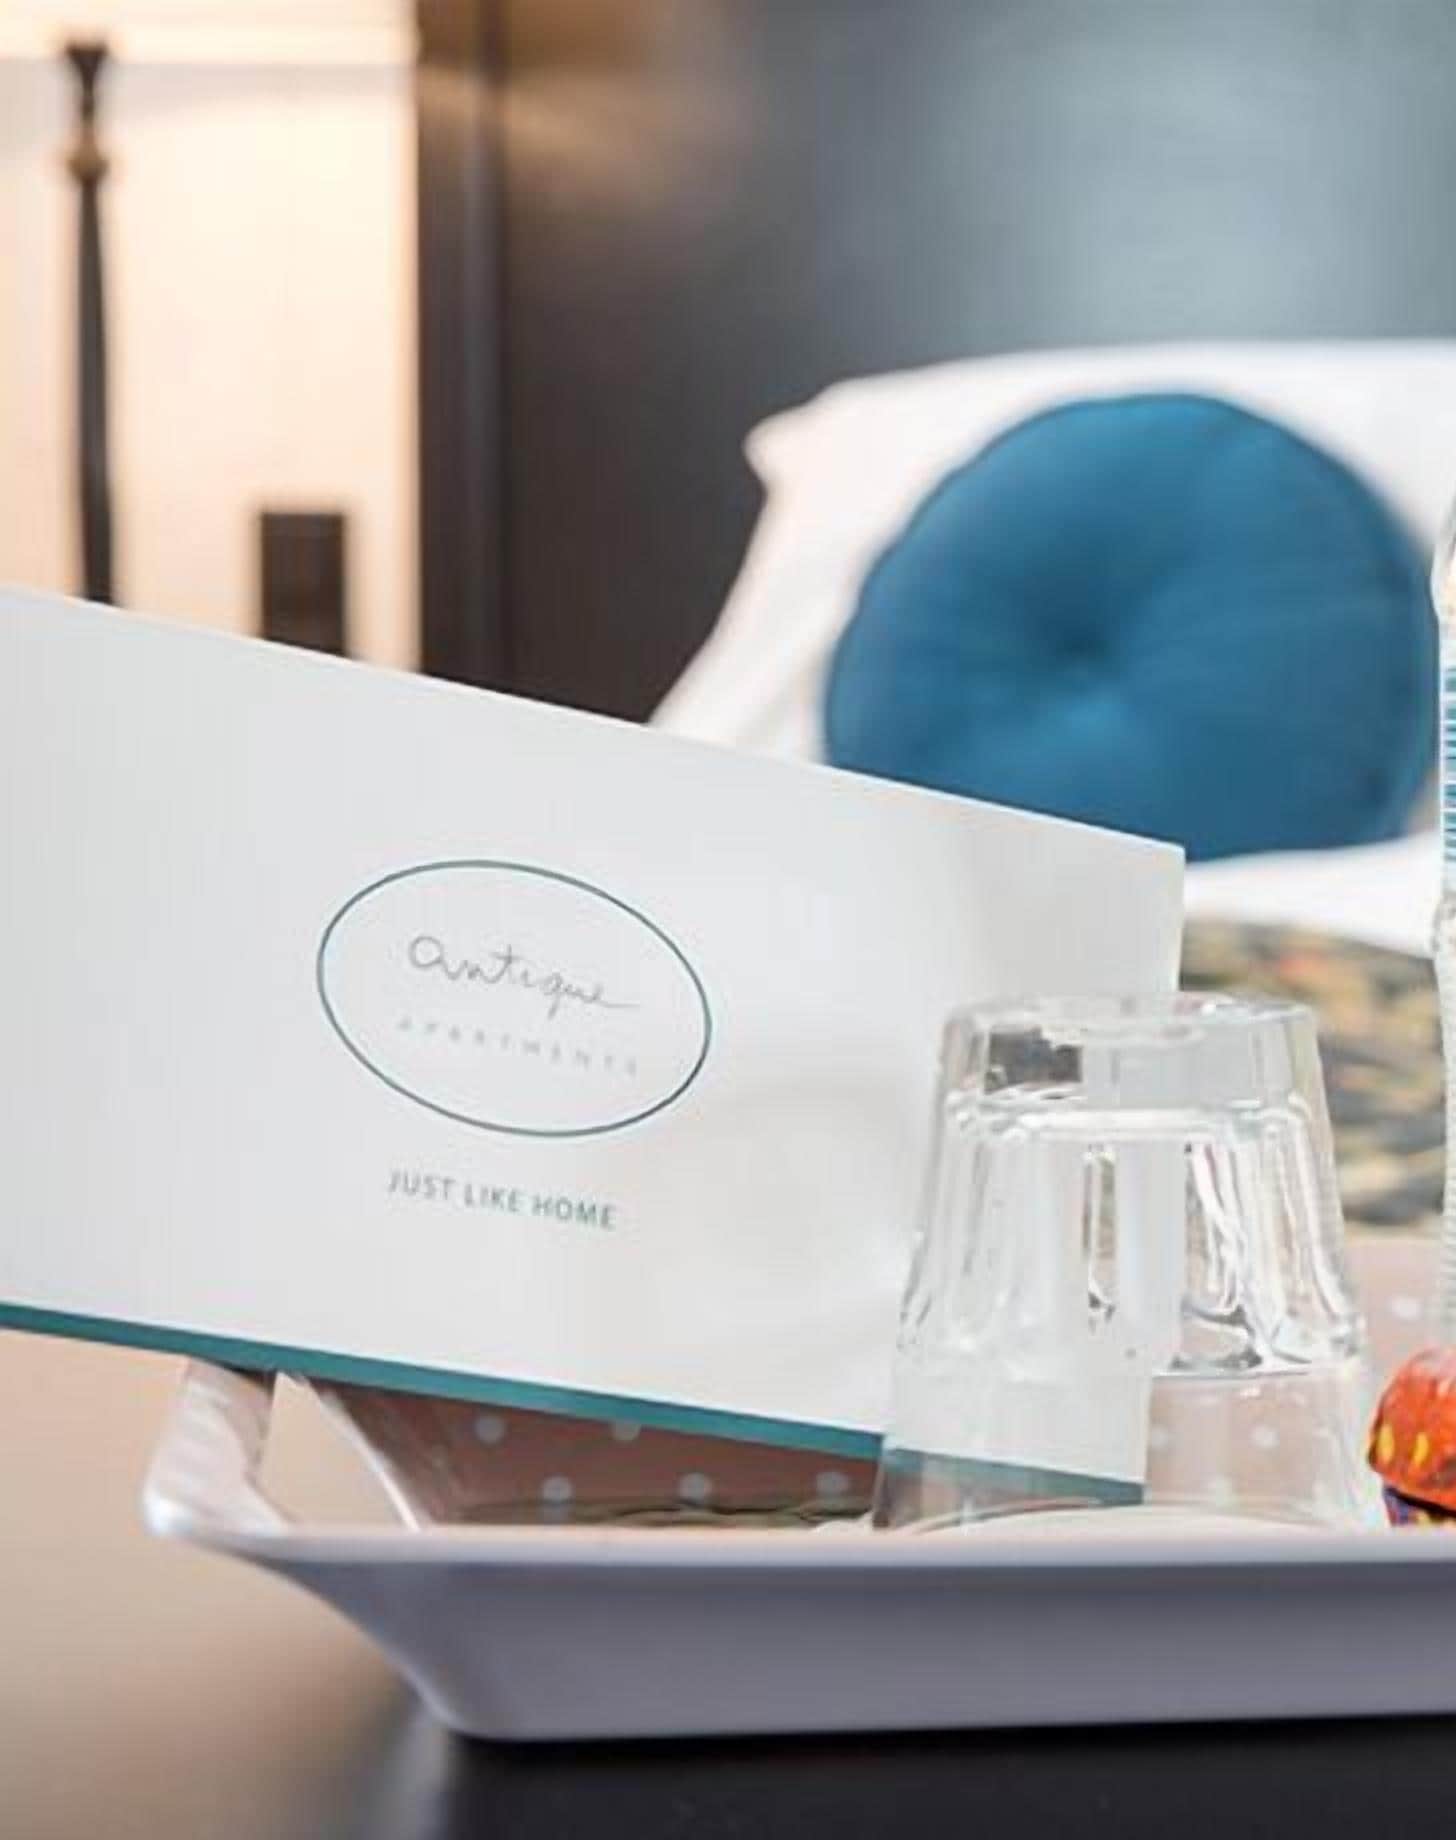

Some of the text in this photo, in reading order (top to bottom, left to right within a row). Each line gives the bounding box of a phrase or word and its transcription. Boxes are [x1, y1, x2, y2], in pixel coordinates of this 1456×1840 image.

[388, 1169, 618, 1232] JUST LIKE HOME
